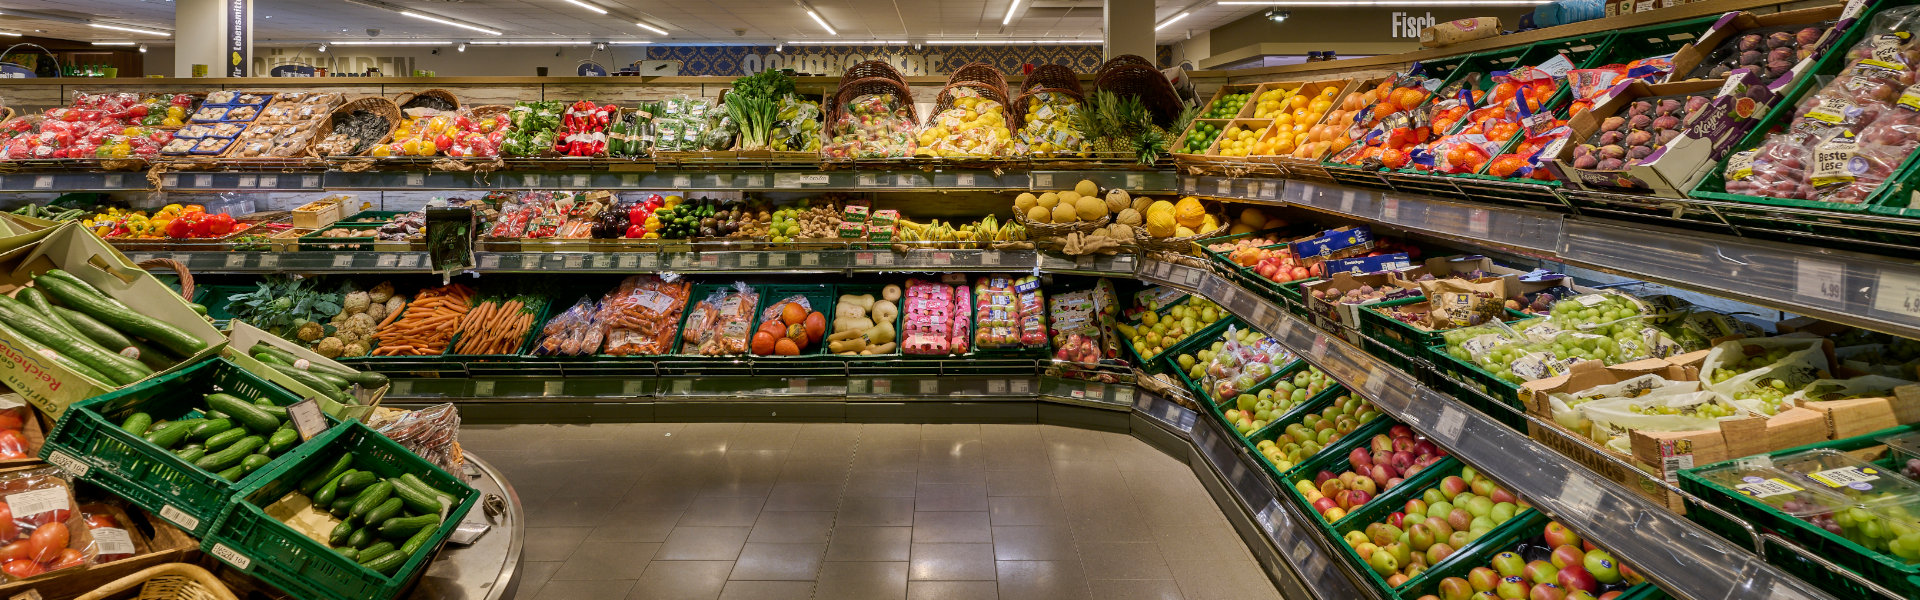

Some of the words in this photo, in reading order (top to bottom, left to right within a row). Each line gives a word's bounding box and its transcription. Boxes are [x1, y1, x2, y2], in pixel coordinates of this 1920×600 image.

[232, 0, 242, 51] Lebensmitt
[1391, 12, 1436, 38] Fisch
[233, 67, 242, 78] ir
[1694, 109, 1727, 138] Kayra
[1818, 152, 1848, 163] Beste
[1821, 162, 1844, 172] Lese
[1821, 282, 1840, 298] 4.99
[1903, 296, 1920, 313] 4.9
[8, 375, 58, 414] Gurken
[73, 463, 86, 473] 104
[235, 555, 247, 566] 104
